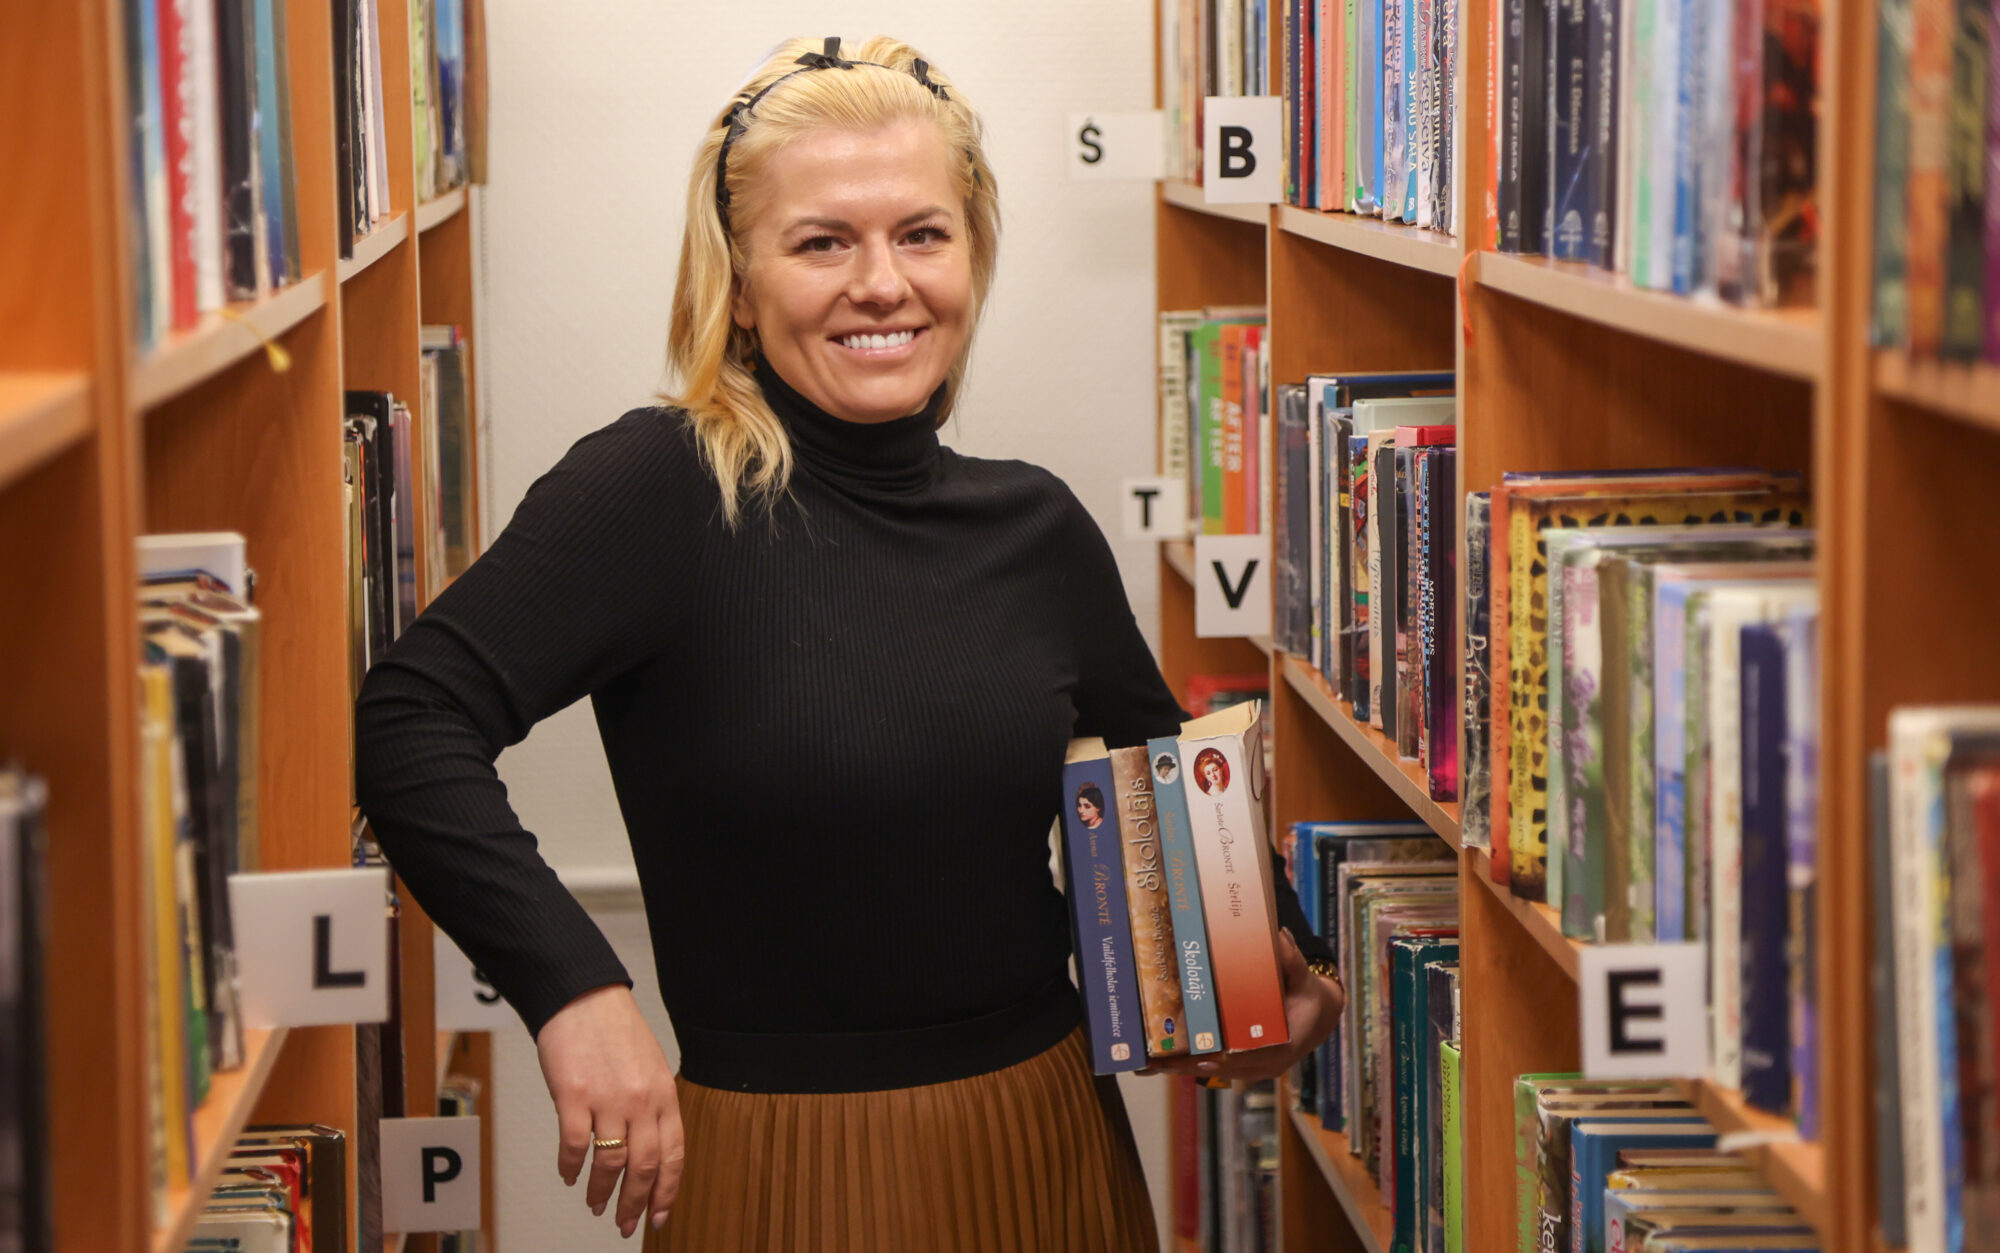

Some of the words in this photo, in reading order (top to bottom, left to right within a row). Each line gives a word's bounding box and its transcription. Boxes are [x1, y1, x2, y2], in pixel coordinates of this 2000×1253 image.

[1219, 125, 1257, 178] B
[1225, 400, 1242, 472] AFTER
[1133, 489, 1159, 529] T
[1212, 560, 1259, 609] V
[1126, 777, 1161, 892] Skolotājs
[312, 915, 366, 989] L
[1101, 936, 1118, 993] Vaildfelholas
[1182, 939, 1205, 1001] Skolotājs
[1109, 994, 1122, 1038] iemītniece
[1605, 969, 1665, 1056] E
[421, 1146, 462, 1203] P
